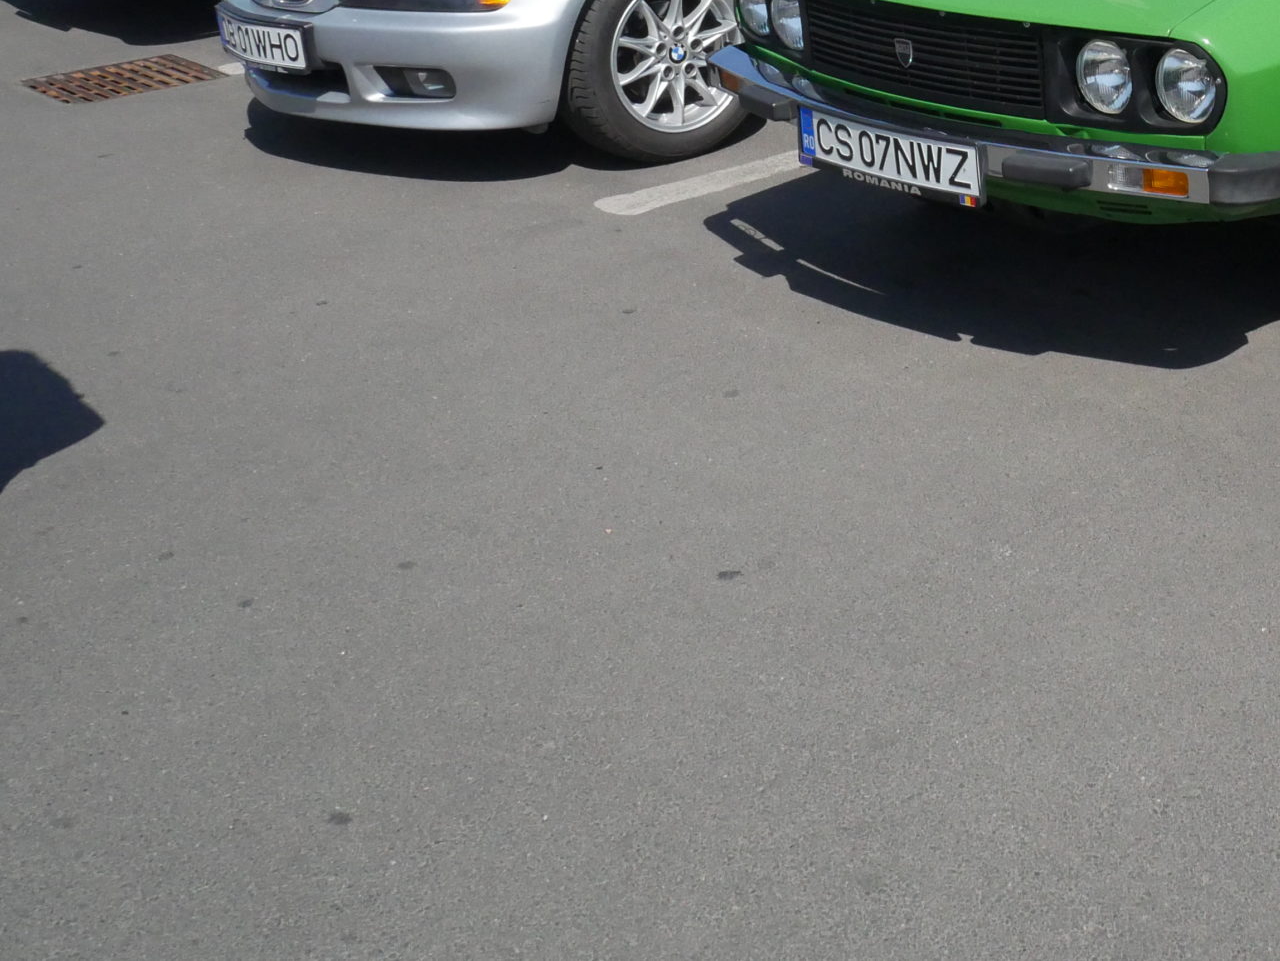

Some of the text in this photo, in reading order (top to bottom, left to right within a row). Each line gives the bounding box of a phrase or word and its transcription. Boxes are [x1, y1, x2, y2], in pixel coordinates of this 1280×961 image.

[803, 133, 815, 150] RO
[816, 118, 853, 162] CS
[842, 168, 922, 196] ROMANIA
